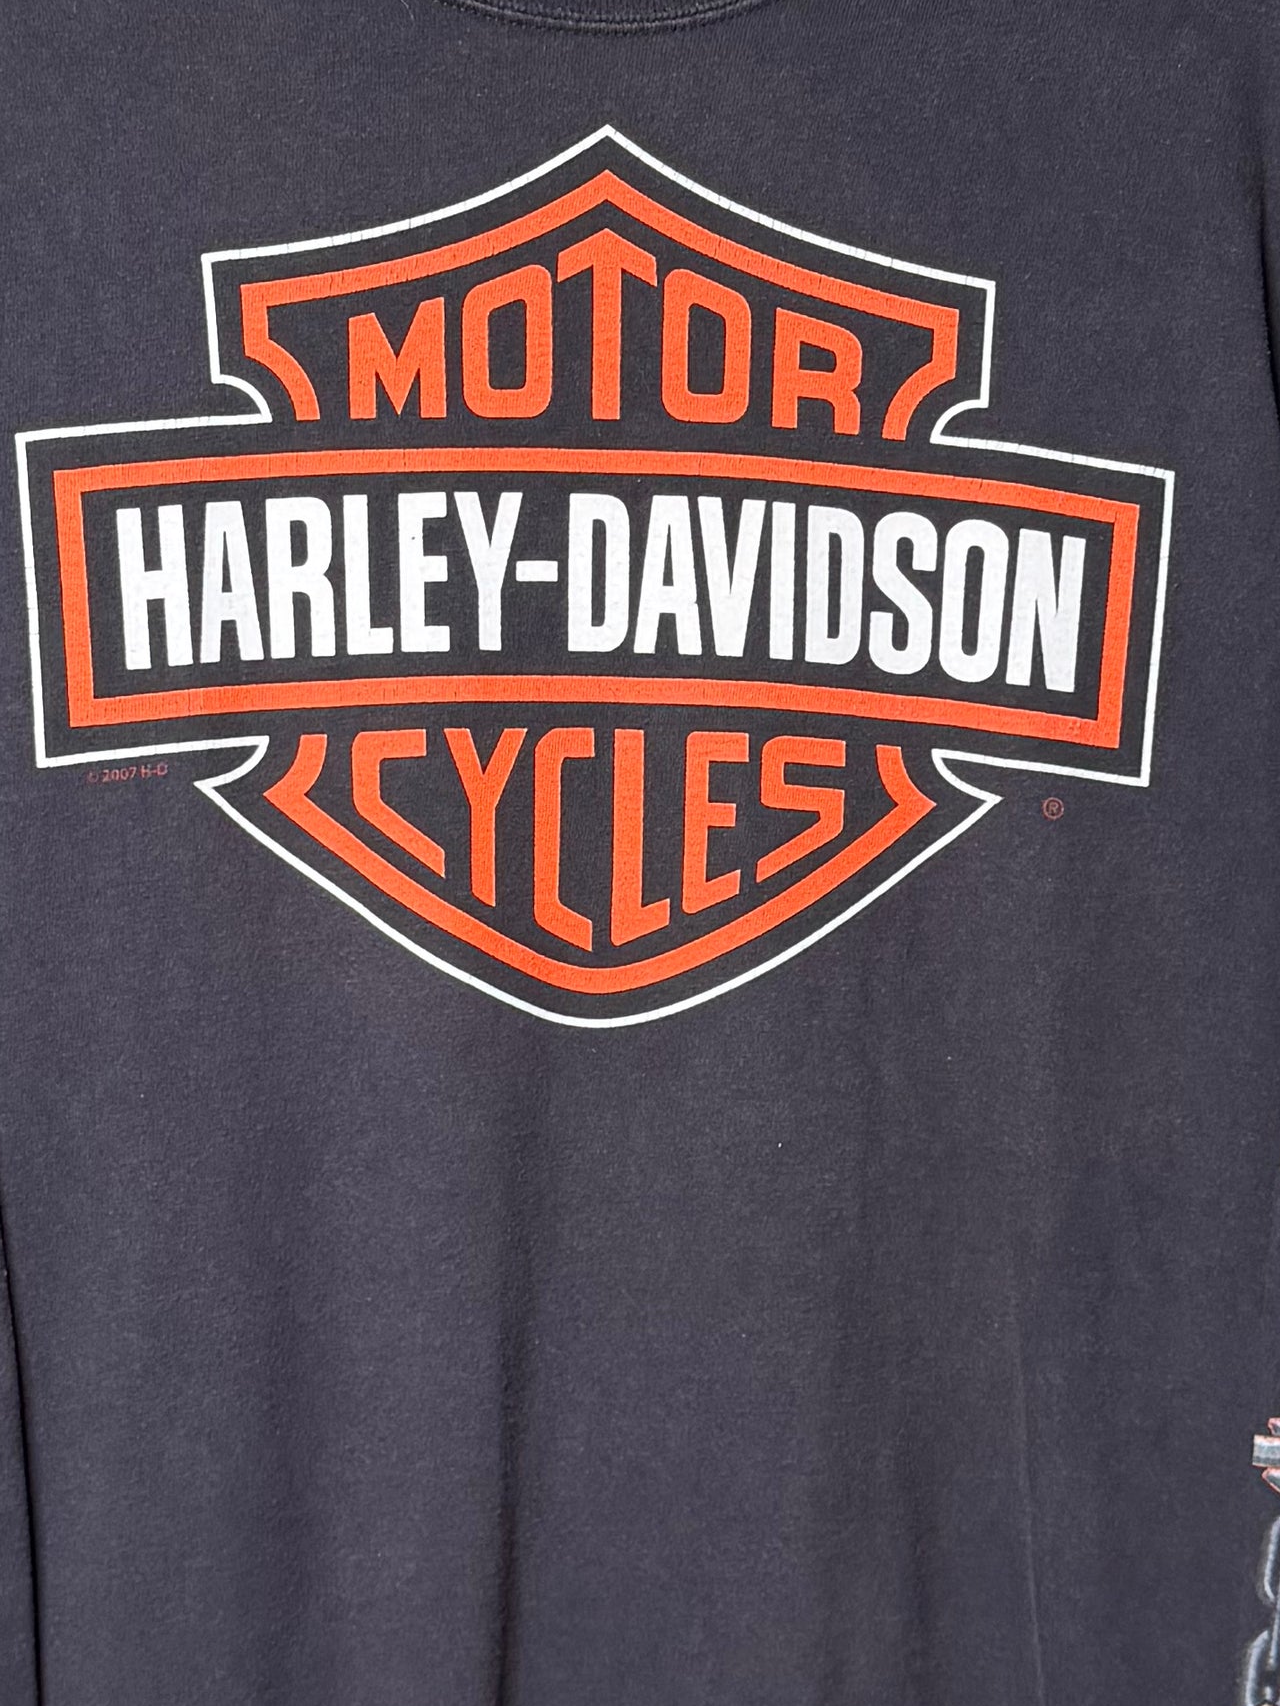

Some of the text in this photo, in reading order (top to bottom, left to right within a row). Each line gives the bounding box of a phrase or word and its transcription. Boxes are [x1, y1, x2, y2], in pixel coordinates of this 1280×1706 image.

[347, 227, 863, 436] MOTOR
[114, 490, 1087, 694] HARLEY-DAVIDSON
[102, 765, 138, 783] 2007
[349, 725, 847, 953] CYCLES
